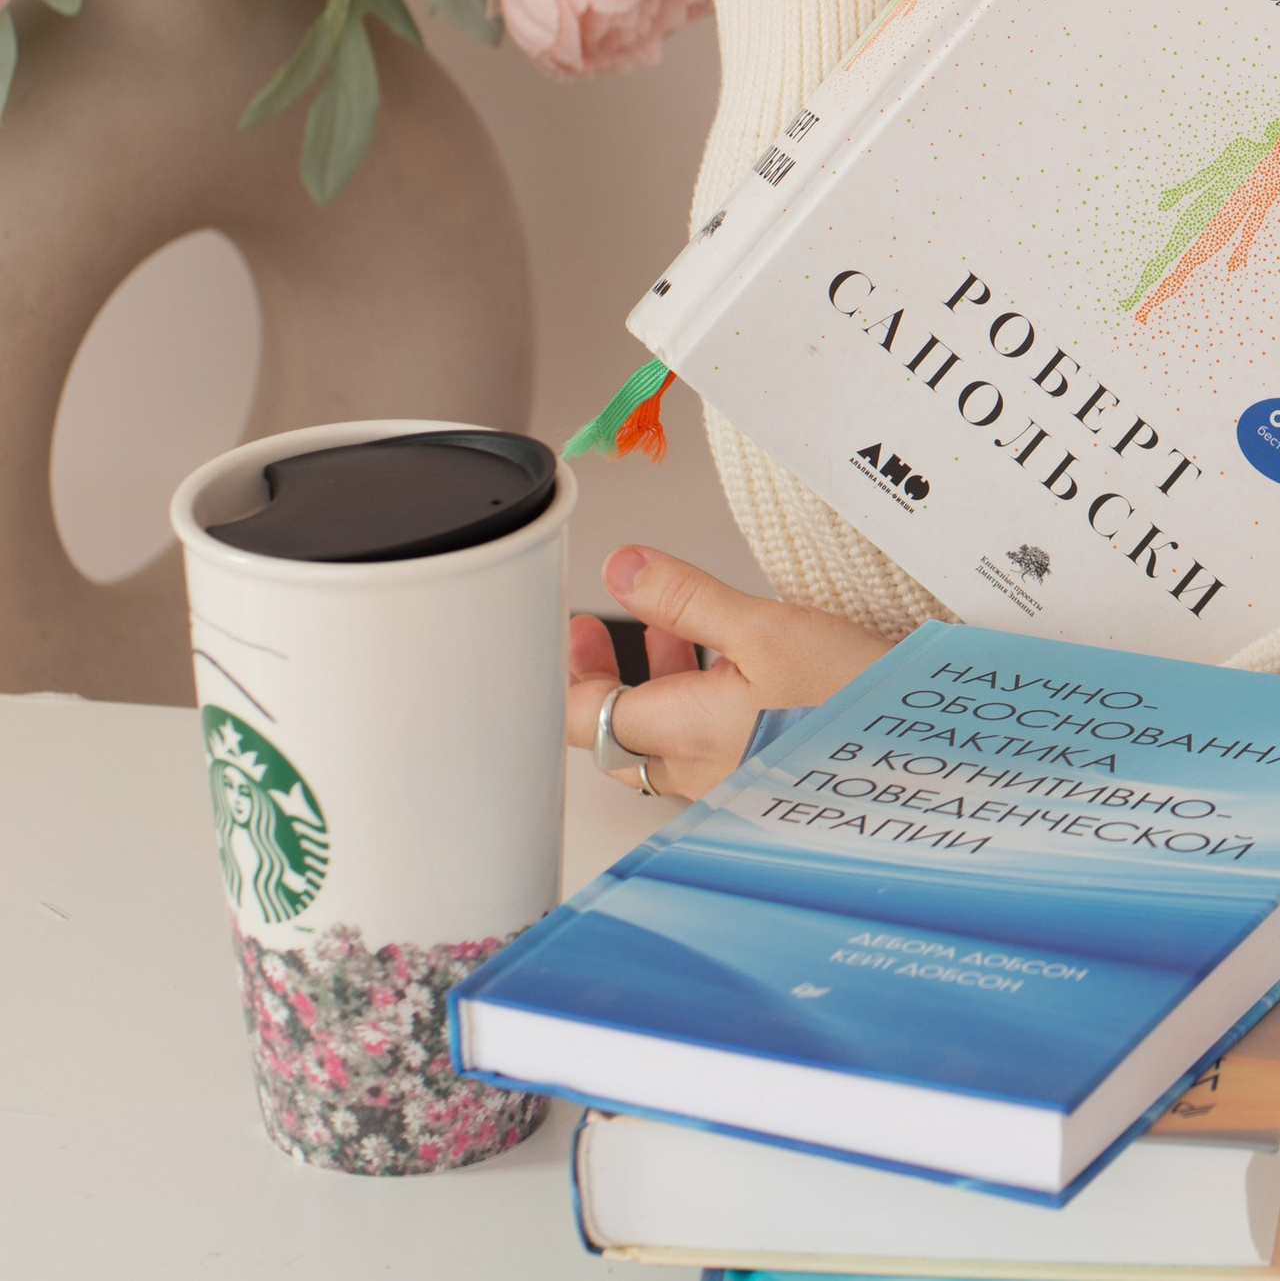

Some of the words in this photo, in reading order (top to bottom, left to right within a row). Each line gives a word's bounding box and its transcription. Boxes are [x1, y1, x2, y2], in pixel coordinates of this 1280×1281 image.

[940, 270, 1202, 498] РОБЕРТ
[828, 270, 1227, 619] САПОЛЬСКИ
[849, 457, 877, 482] АЛЬПИНА
[975, 565, 1008, 594] Дмитрия
[1008, 591, 1034, 617] Зимина
[980, 555, 1014, 586] Книжные
[1014, 585, 1043, 611] проекты
[930, 662, 1159, 712] НАУЧНО-
[863, 715, 1117, 773] ПРАКТИКА
[828, 742, 862, 762] В
[872, 749, 1233, 821] КОГНИТИВНО-
[760, 797, 994, 855] ТЕРАПИИ
[793, 770, 1256, 862] ПОВЕДЕНЧЕСКОЙ
[829, 948, 899, 970] КЕЙТ
[894, 962, 1024, 993] ДОБСОН
[848, 932, 956, 960] ДЕБОРА
[959, 950, 1089, 982] ДОБСОН
